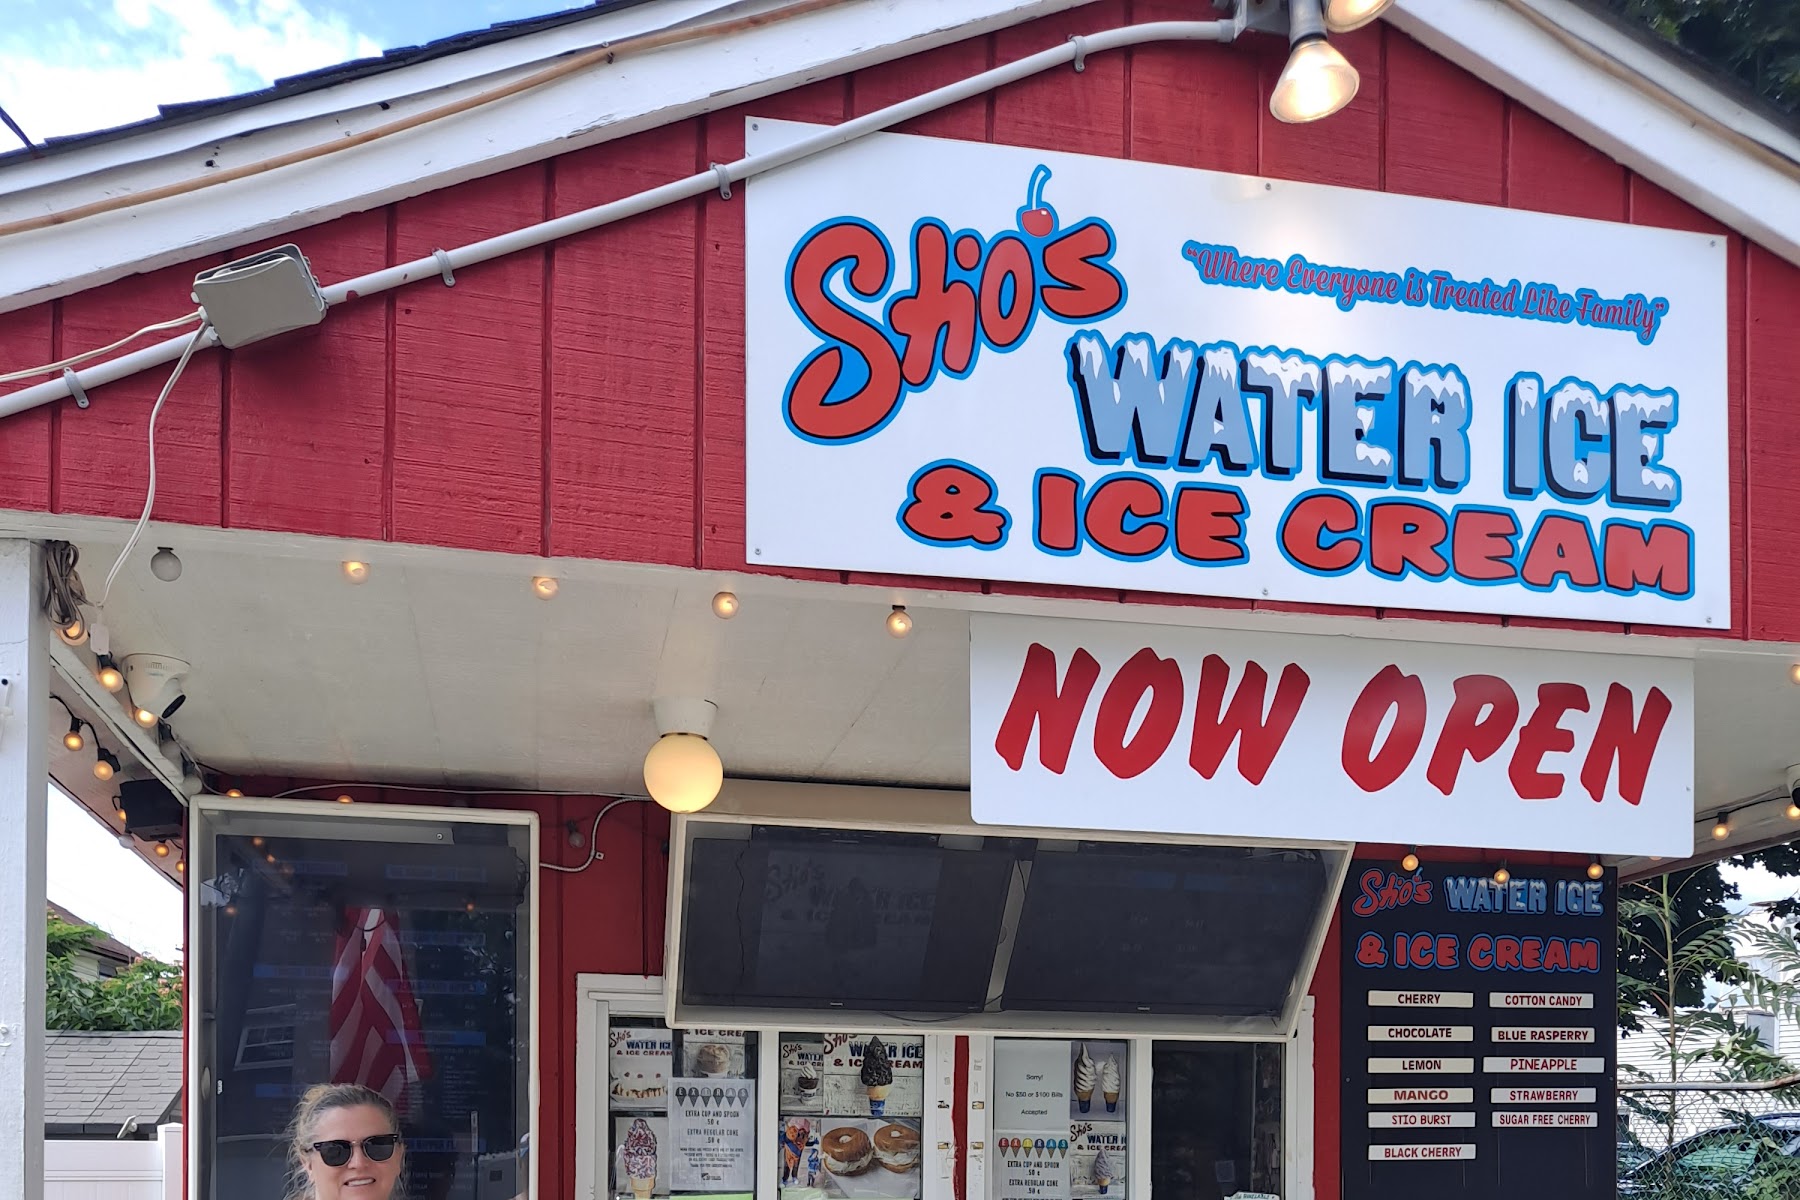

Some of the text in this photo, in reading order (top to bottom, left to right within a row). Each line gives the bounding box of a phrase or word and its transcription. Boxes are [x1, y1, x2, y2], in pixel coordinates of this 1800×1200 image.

[1287, 259, 1397, 307] Everyone
[1406, 272, 1423, 300] is
[1432, 274, 1516, 311] Treated
[1523, 287, 1570, 318] Like
[1068, 330, 1679, 508] WATER ICE
[899, 460, 1693, 598] & ICE CREAM
[996, 642, 1671, 805] NOW OPEN
[1444, 877, 1547, 914] WATER
[1554, 881, 1603, 915] ICE
[1355, 932, 1600, 973] & ICE CREAM
[1398, 994, 1441, 1005] CHERRY
[1505, 995, 1582, 1006] COTTON CANDY
[1388, 1027, 1452, 1038] CHOCOLATE
[1498, 1030, 1588, 1041] BLUE RASPERRY
[626, 1040, 656, 1050] WATER
[902, 1043, 923, 1058] ICE
[888, 1060, 923, 1069] REAM
[1402, 1060, 1441, 1071] LEMON
[1510, 1059, 1577, 1070] PINEAPPLE
[1026, 1074, 1043, 1082] Sorry!
[1394, 1090, 1448, 1101] MANGO
[1510, 1090, 1578, 1101] STRAWBERRY
[1392, 1114, 1451, 1125] STIO BURST
[1499, 1115, 1590, 1125] SUGAR FREE CHERRY
[1087, 1134, 1118, 1144] WATER
[1385, 1147, 1462, 1158] BLACK CHERRY
